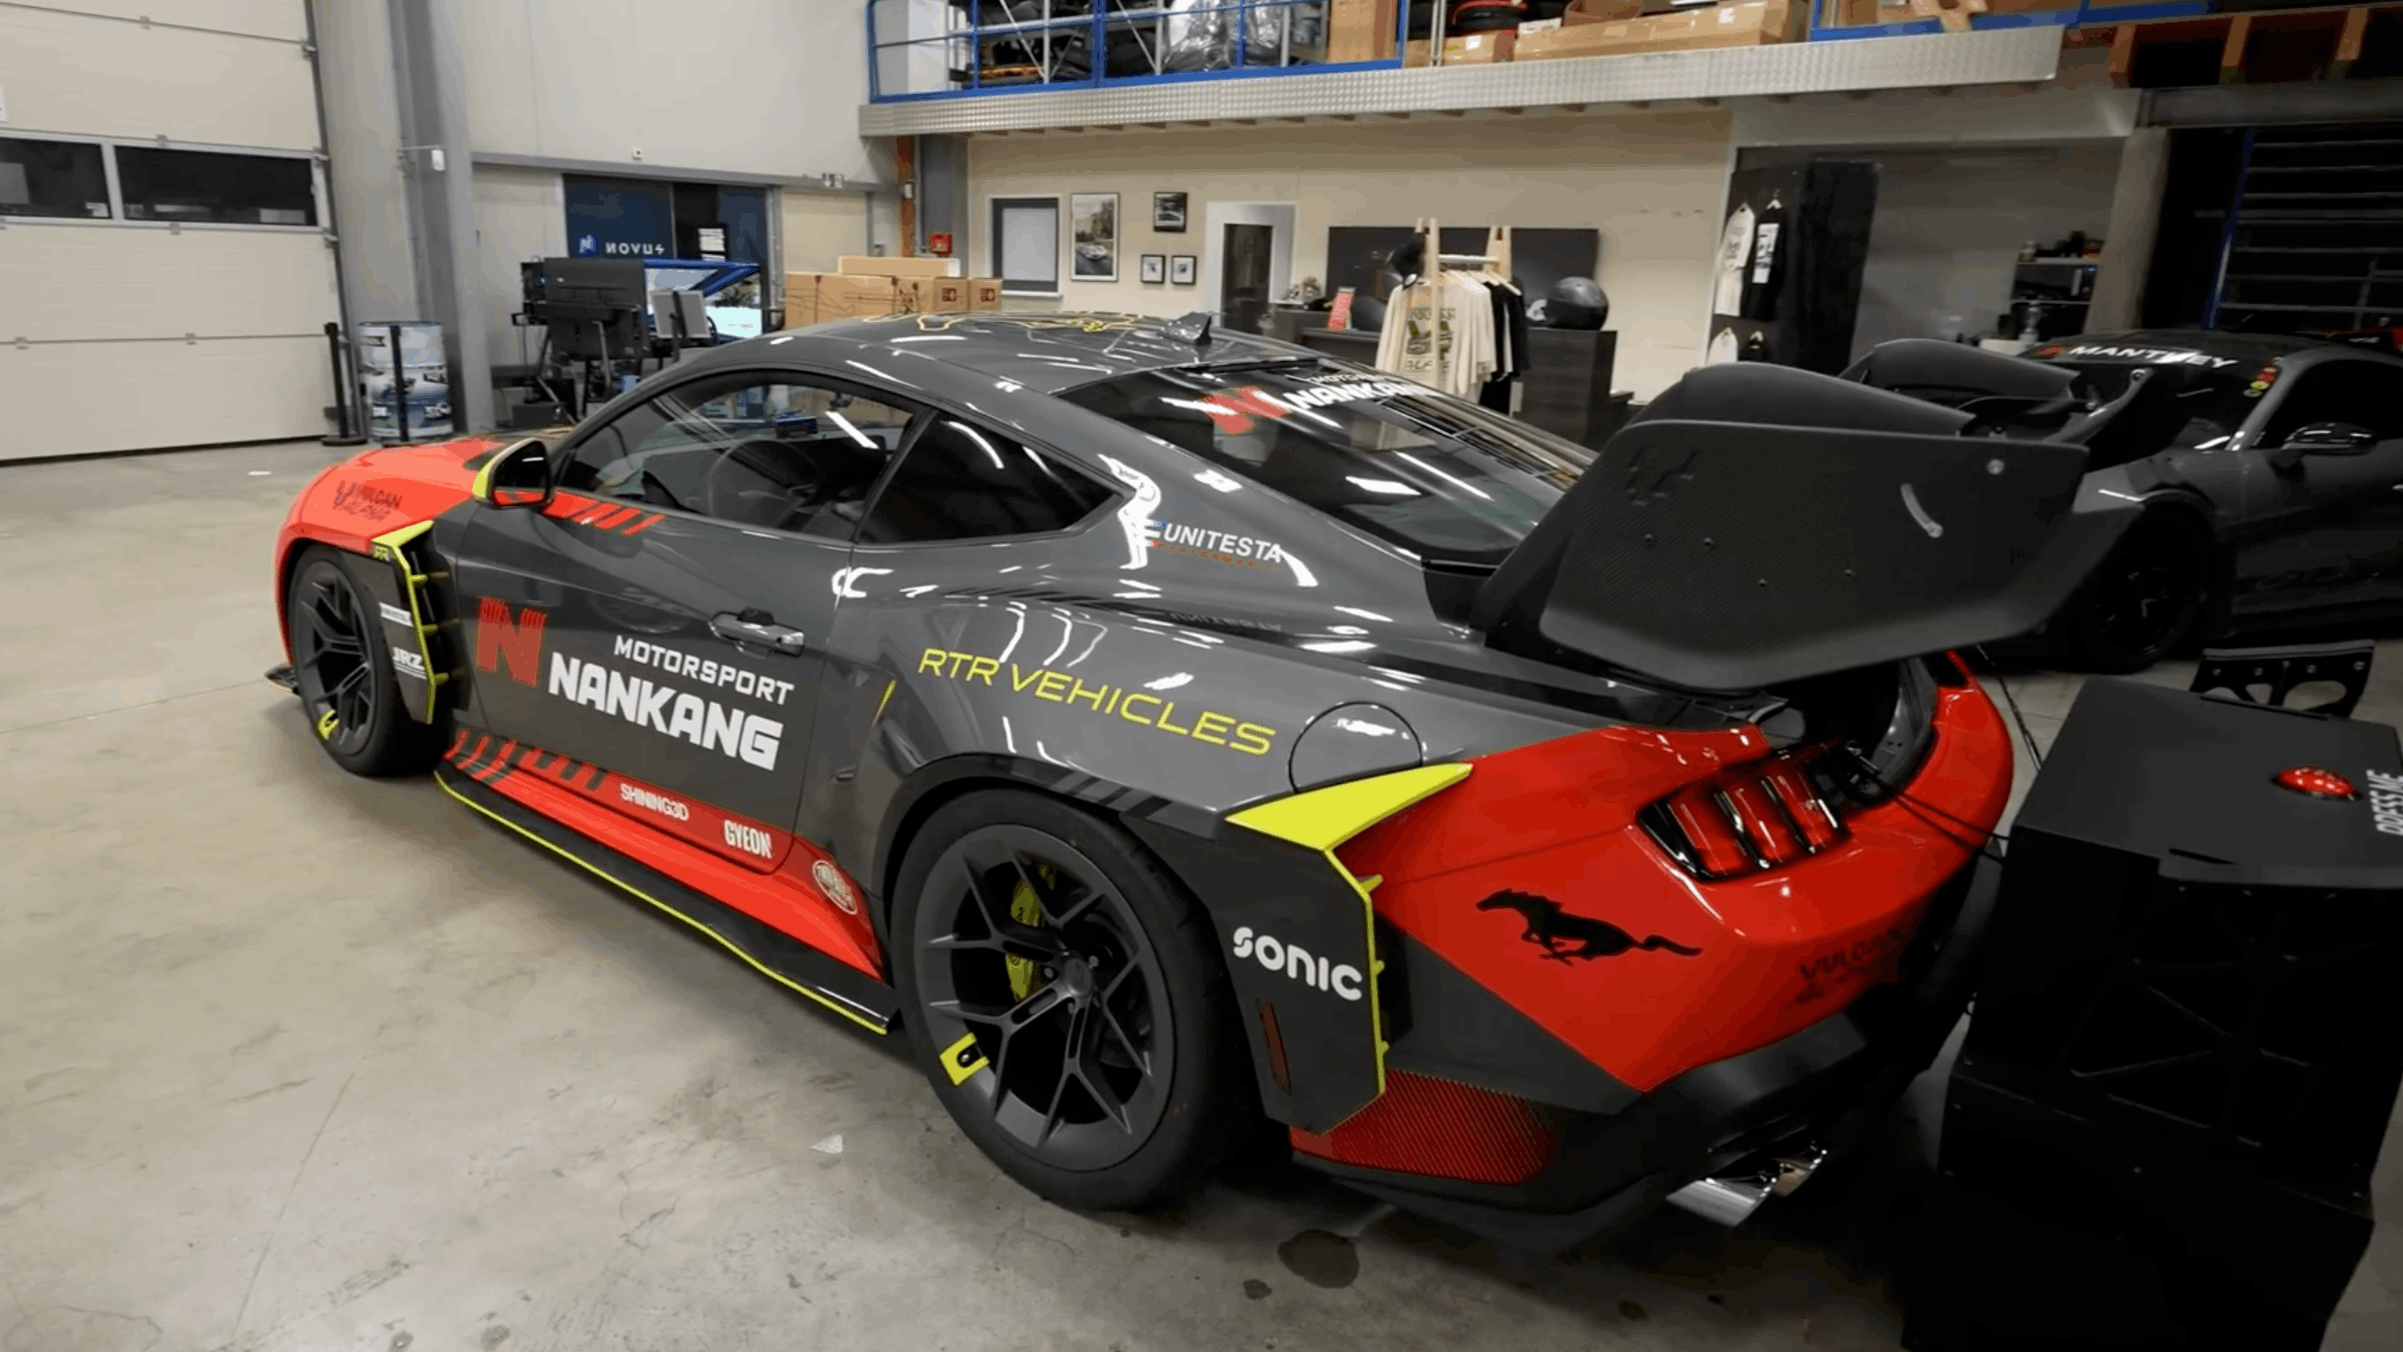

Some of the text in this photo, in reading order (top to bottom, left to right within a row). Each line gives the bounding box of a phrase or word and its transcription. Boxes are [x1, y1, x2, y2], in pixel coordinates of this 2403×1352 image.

[2069, 345, 2239, 369] MANTEY
[1163, 522, 1282, 564] UNITESTA
[613, 635, 795, 705] MOTORSPORT
[548, 651, 784, 771] NANKANG
[918, 648, 1276, 755] RTR VEHICLES
[620, 783, 690, 821] SHINING3D
[723, 820, 773, 859] GYEON
